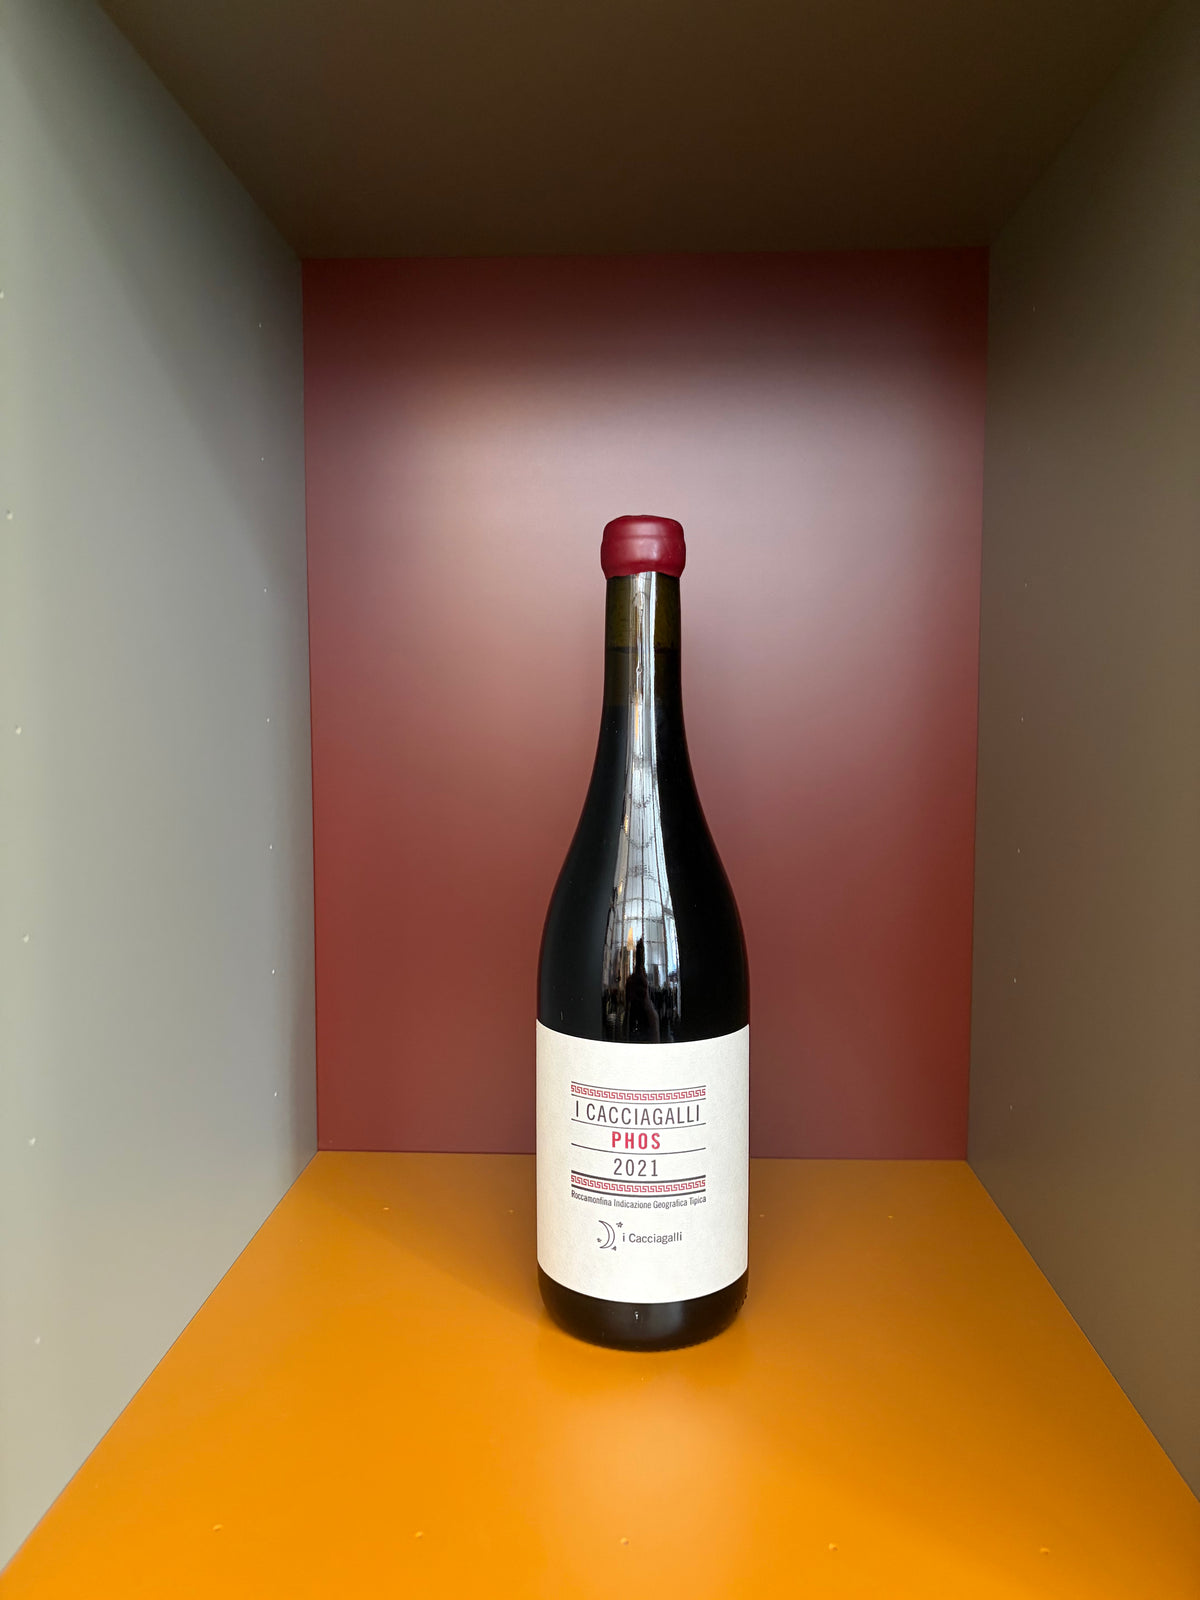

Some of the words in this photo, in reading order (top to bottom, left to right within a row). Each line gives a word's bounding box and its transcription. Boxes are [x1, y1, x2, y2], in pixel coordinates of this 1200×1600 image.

[576, 1100, 579, 1118] I
[586, 1103, 700, 1126] CACCIAGALLI
[611, 1130, 661, 1150] PHOS
[613, 1157, 658, 1177] 2021
[571, 1189, 612, 1207] Roccamonfina
[613, 1198, 652, 1209] Indicazione
[653, 1199, 688, 1210] Geografica
[689, 1195, 707, 1207] Tipica
[622, 1232, 626, 1243] i
[628, 1231, 683, 1245] Cacciagalli
